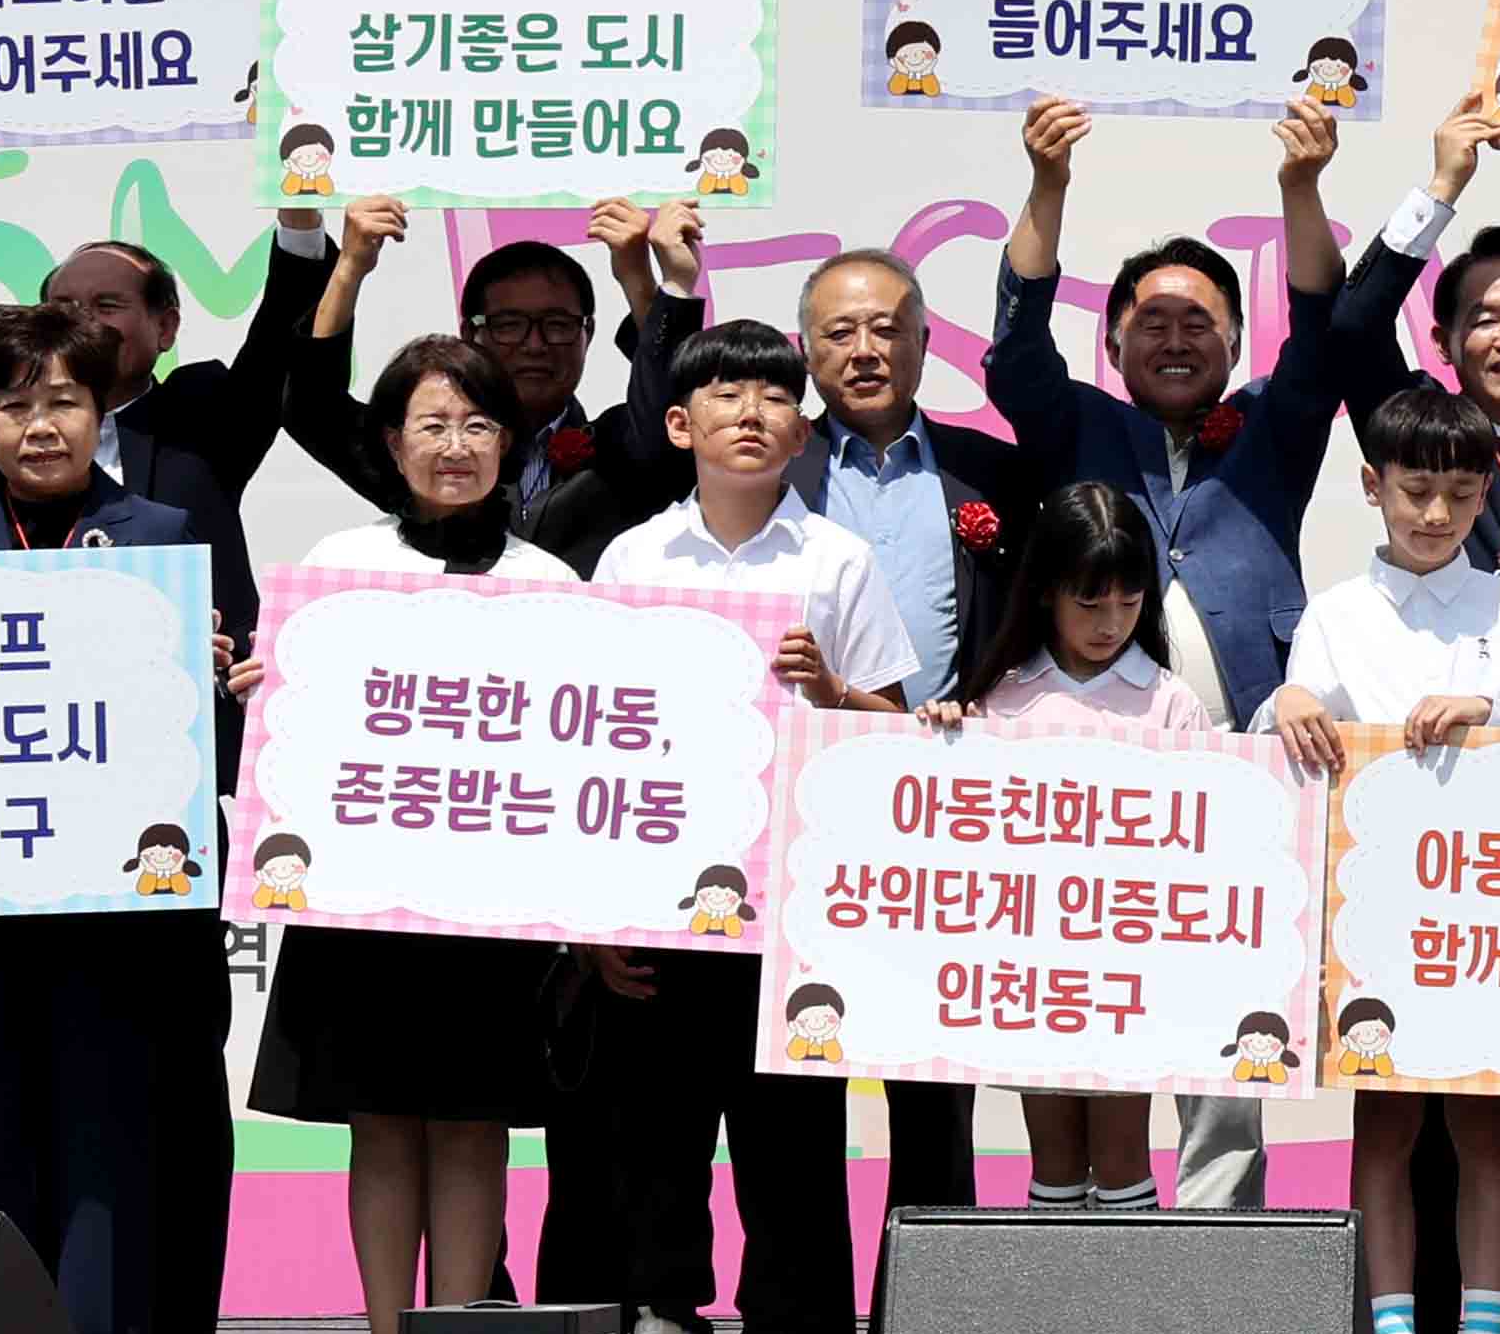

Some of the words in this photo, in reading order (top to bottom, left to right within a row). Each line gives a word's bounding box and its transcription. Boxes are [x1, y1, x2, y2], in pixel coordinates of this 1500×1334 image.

[350, 13, 562, 73] 살기좋은
[581, 14, 684, 71] 도시
[346, 94, 452, 157] 함께
[474, 99, 684, 158] 만들어요
[364, 667, 530, 742] 행복한
[550, 684, 670, 755] 아동,
[332, 763, 555, 835] 존중받는
[577, 777, 686, 844] 아동
[893, 775, 1207, 853] 아동친화도시
[825, 865, 1036, 936] 상위단계
[1058, 876, 1264, 948] 인증도시
[938, 960, 1146, 1034] 인천동구
